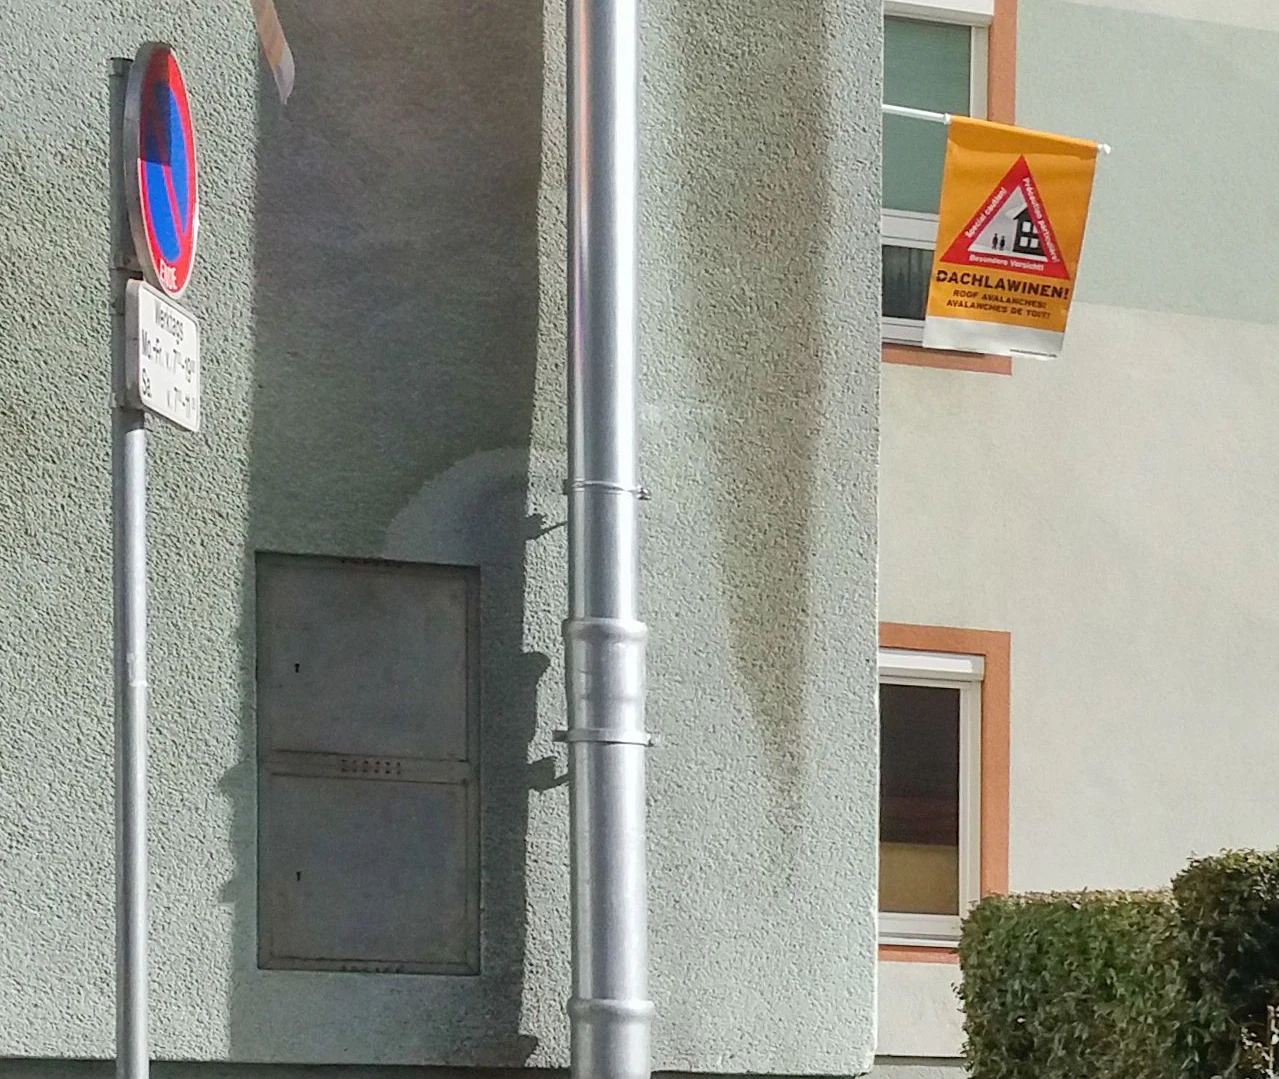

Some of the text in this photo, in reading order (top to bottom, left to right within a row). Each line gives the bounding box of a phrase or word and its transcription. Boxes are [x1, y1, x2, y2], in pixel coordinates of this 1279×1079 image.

[936, 270, 1070, 300] DACHLAWINEN!
[946, 299, 1008, 314] AVALANCHES
[1010, 306, 1024, 317] DE
[953, 289, 1047, 309] ROOF AVALANCHES!
